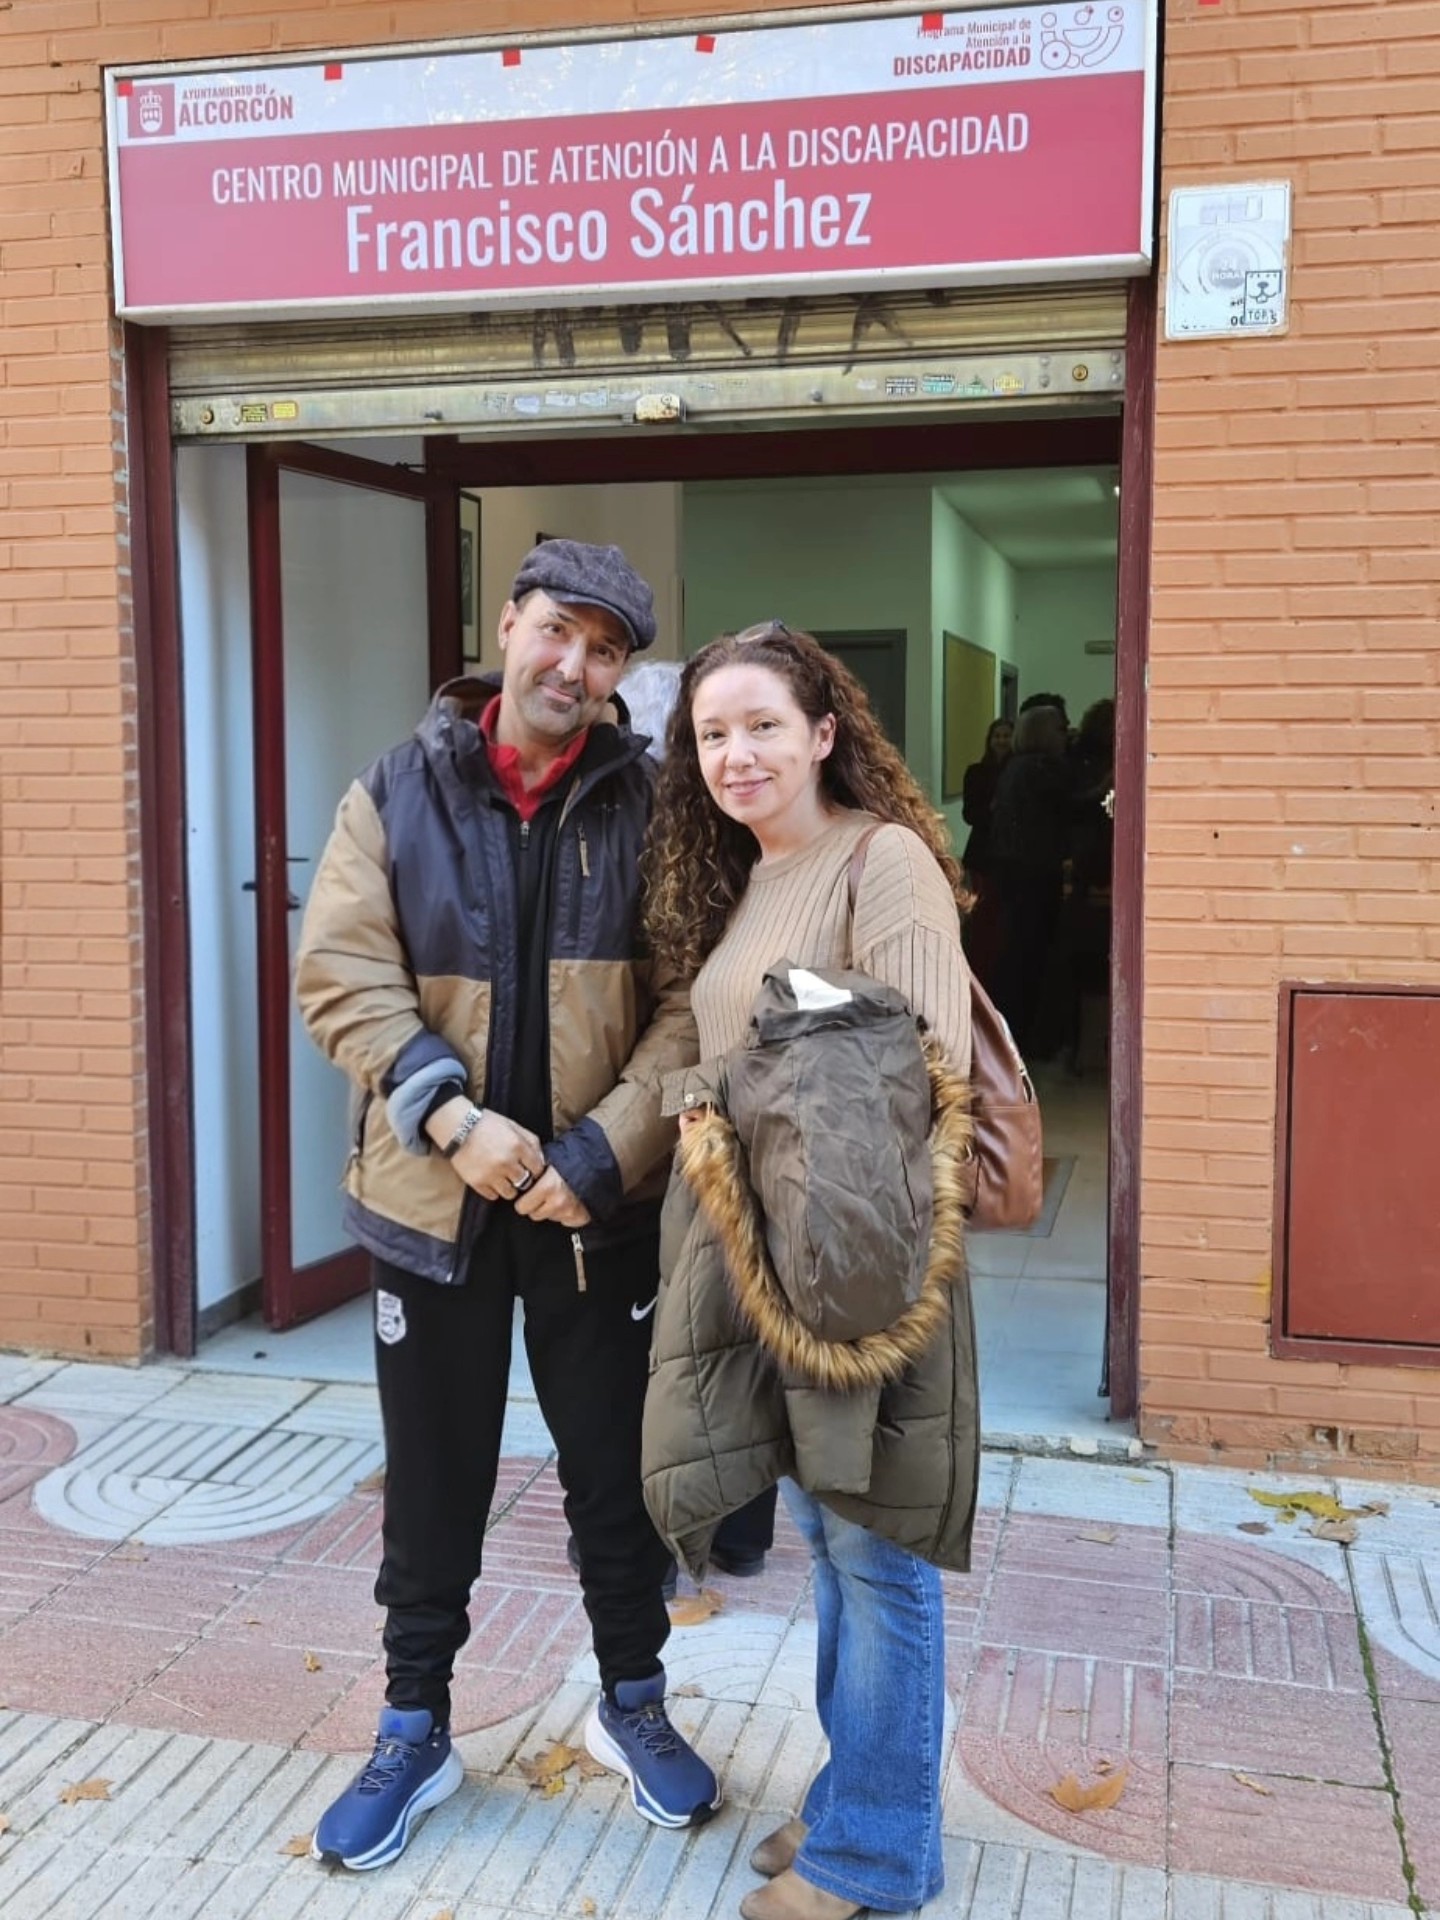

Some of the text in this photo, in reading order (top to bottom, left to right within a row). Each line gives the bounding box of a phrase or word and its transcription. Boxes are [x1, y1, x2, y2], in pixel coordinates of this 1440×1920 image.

[965, 35, 1010, 49] Atención
[1021, 33, 1031, 44] la
[967, 19, 1017, 36] Municipal
[1018, 18, 1032, 30] de
[893, 46, 1031, 77] DISCAPACIDAD
[182, 83, 267, 99] AYUNTAMIENTO DE
[179, 88, 293, 127] ALCORCÓN
[211, 112, 1029, 204] CENTRO MUNICIPAL DE ATENCIÓN A LA DISCAPACIDAD
[346, 178, 872, 273] Francisco Sánchez
